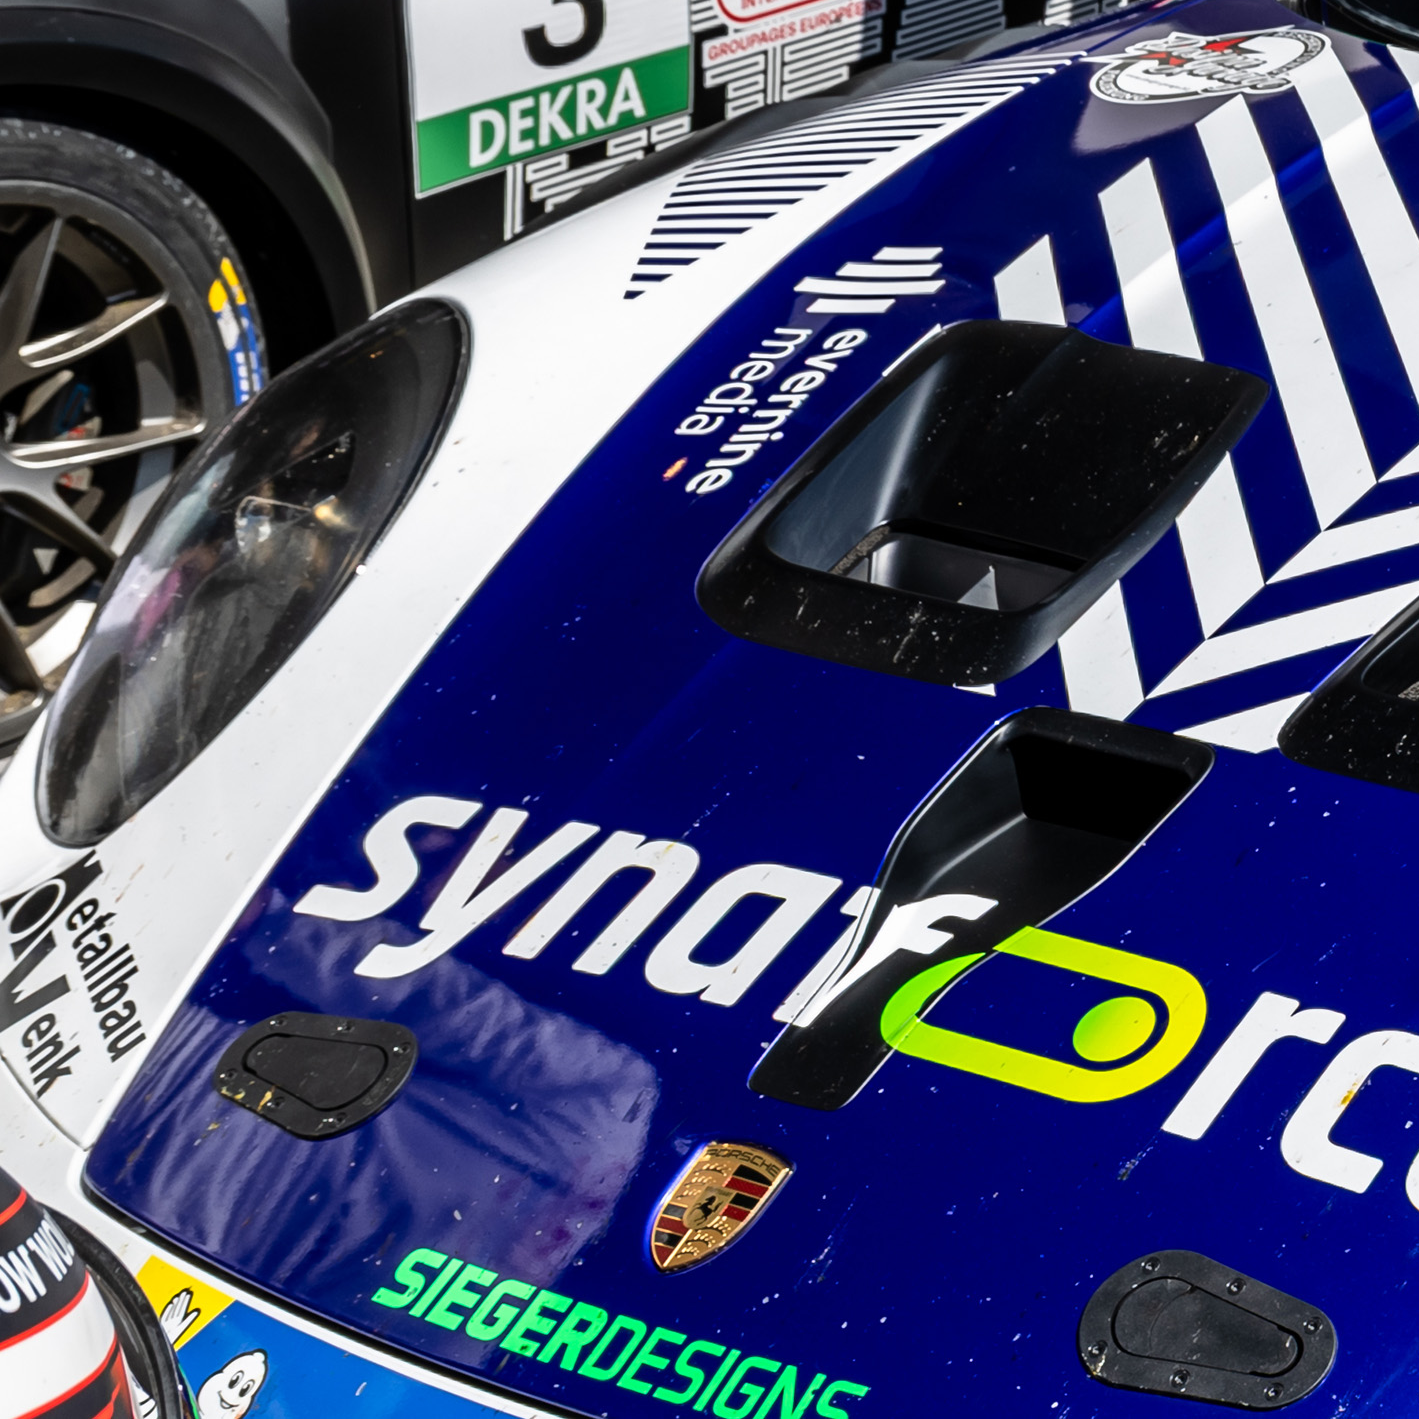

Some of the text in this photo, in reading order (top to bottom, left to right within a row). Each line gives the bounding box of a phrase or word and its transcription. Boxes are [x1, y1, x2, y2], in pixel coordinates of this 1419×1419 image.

[467, 67, 648, 169] DEKRA
[674, 327, 815, 436] media
[685, 328, 867, 495] evernine
[706, 1148, 781, 1179] PORSCHE
